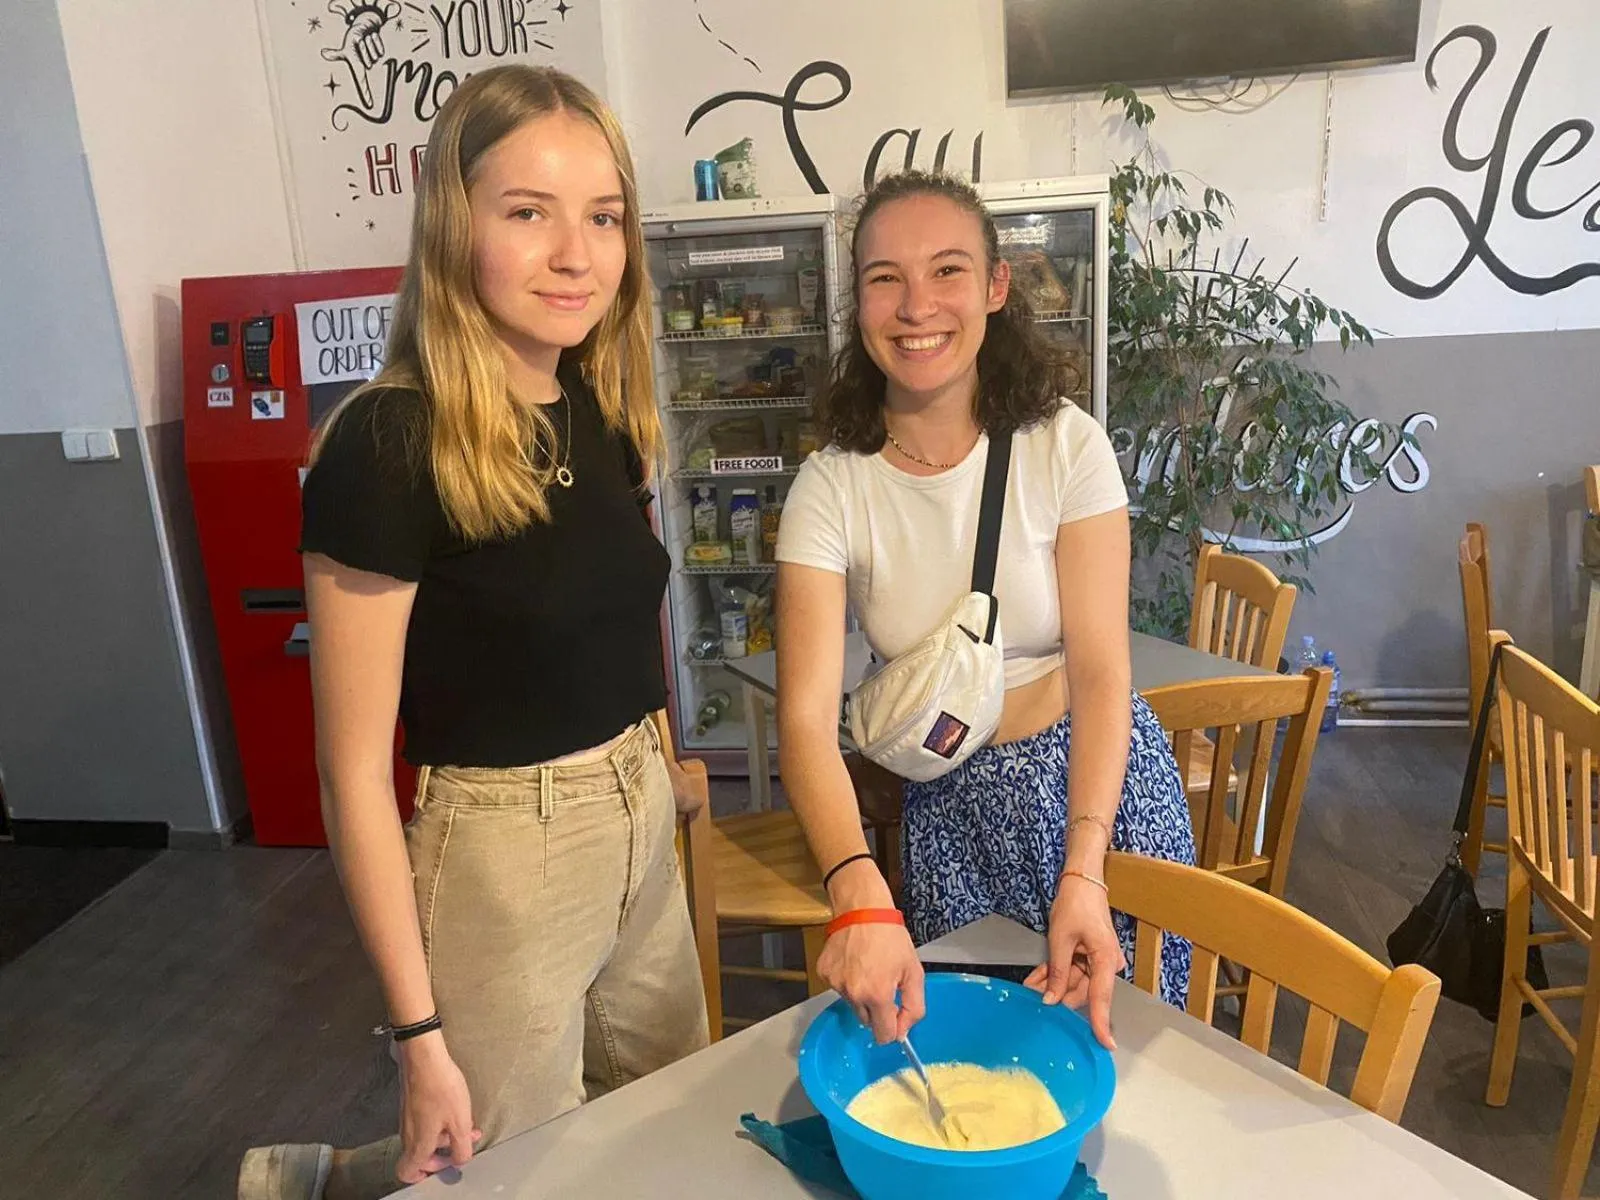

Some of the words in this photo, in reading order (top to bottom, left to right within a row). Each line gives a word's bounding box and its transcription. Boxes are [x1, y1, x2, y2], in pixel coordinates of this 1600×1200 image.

[429, 0, 528, 59] YOUR
[312, 307, 360, 344] OUT
[363, 305, 393, 340] OF
[319, 342, 385, 376] ORDER
